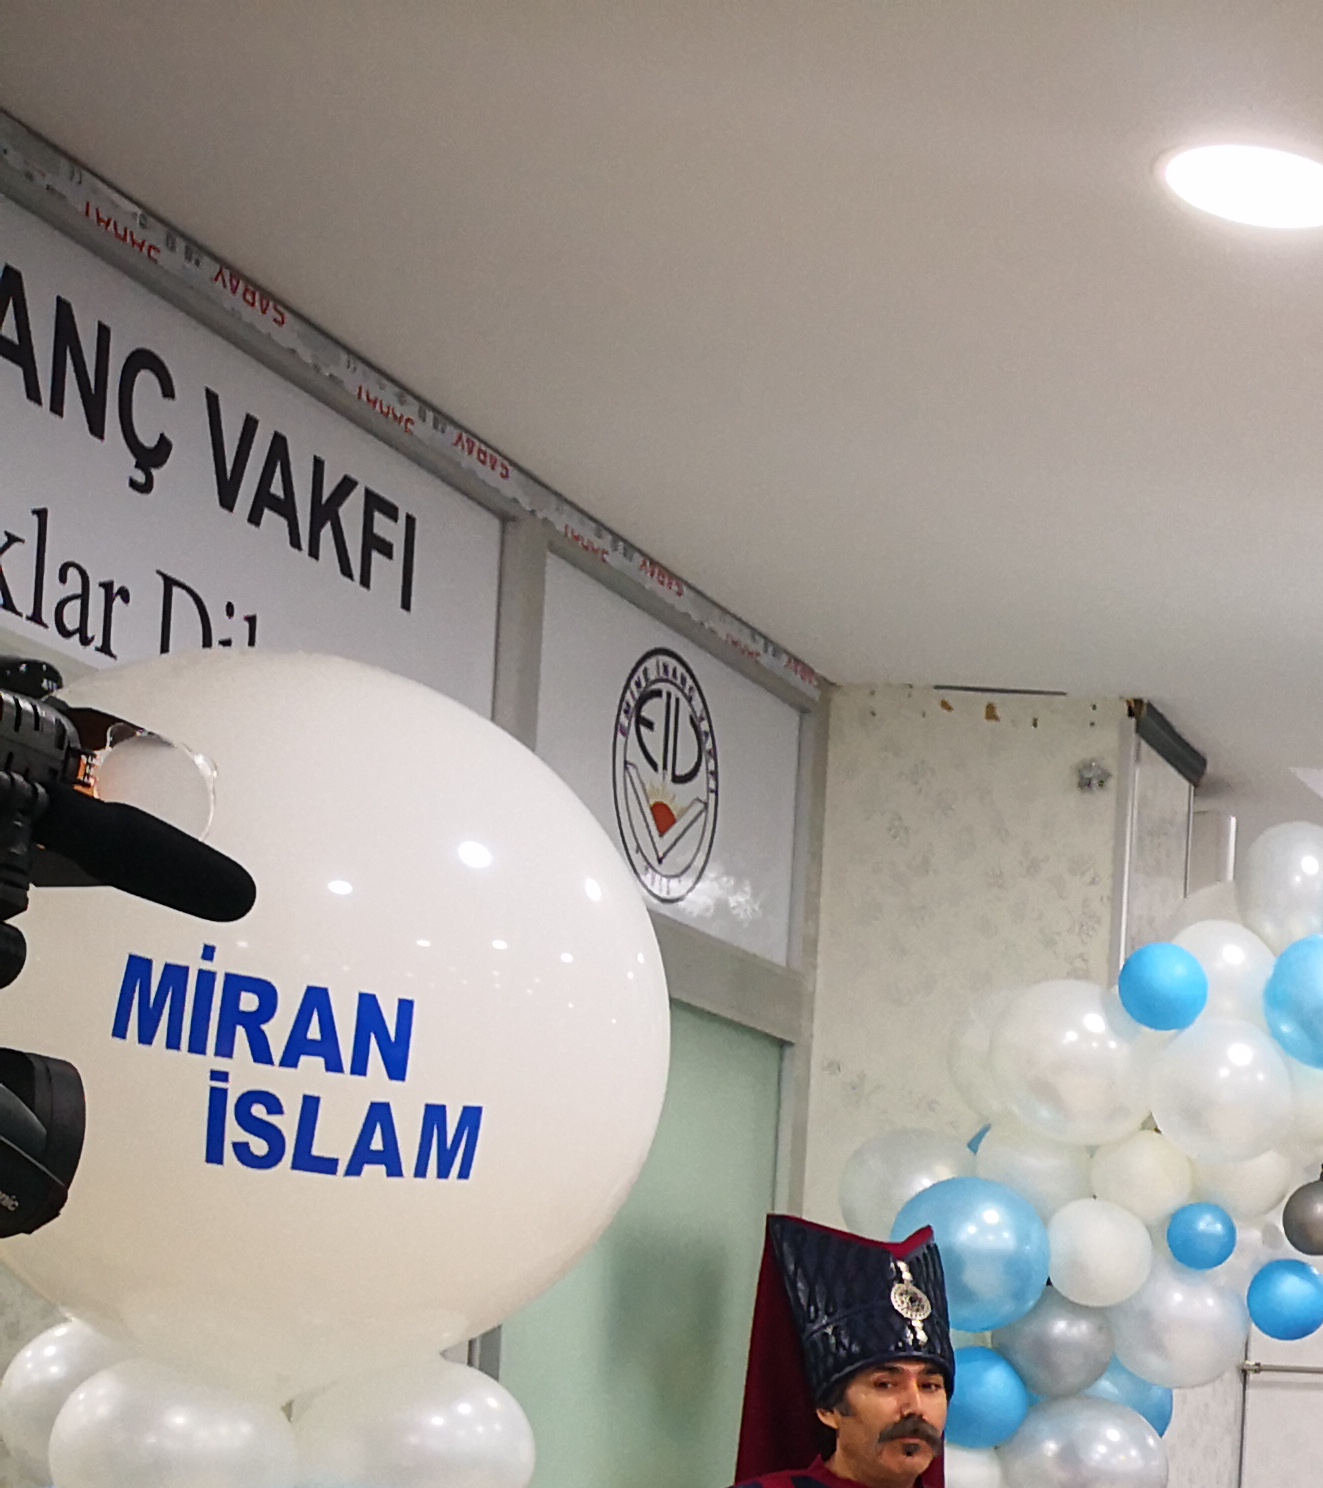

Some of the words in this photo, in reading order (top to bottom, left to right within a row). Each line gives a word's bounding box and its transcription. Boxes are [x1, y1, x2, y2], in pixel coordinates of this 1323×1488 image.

[204, 386, 417, 614] VAKFI
[111, 943, 415, 1082] MİRAN
[205, 1069, 484, 1180] İSLAM
